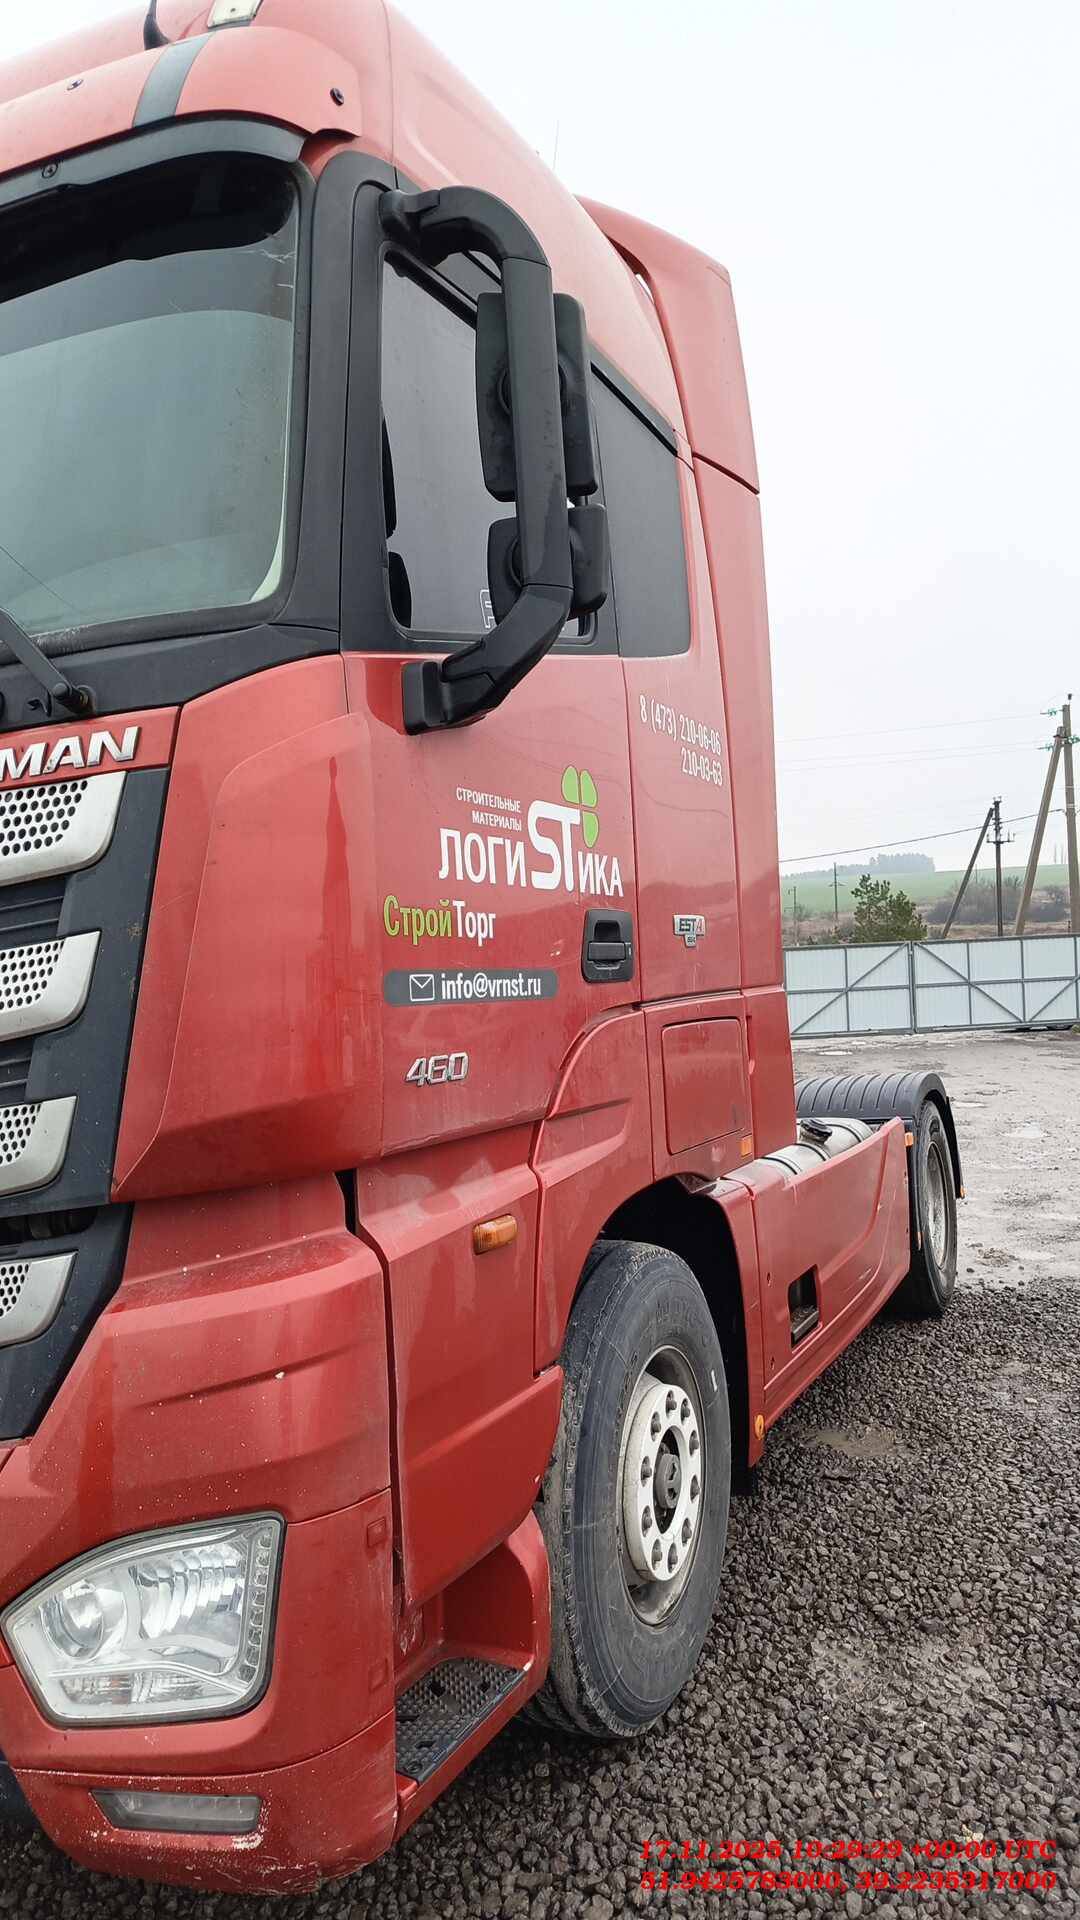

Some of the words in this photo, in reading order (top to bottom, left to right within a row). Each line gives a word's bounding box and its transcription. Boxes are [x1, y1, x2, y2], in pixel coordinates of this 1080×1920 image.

[639, 694, 648, 723] 8
[651, 698, 677, 741] (473)
[679, 713, 721, 755] 210-06-06
[0, 726, 139, 781] MAN
[681, 747, 722, 786] 210-03-63
[456, 787, 521, 813] СТРОИТЕЛЬНЫЕ
[472, 810, 522, 832] МАТЕРИАЛЫ
[441, 972, 542, 1000] info@vrnst.ru
[405, 1051, 469, 1087] 460
